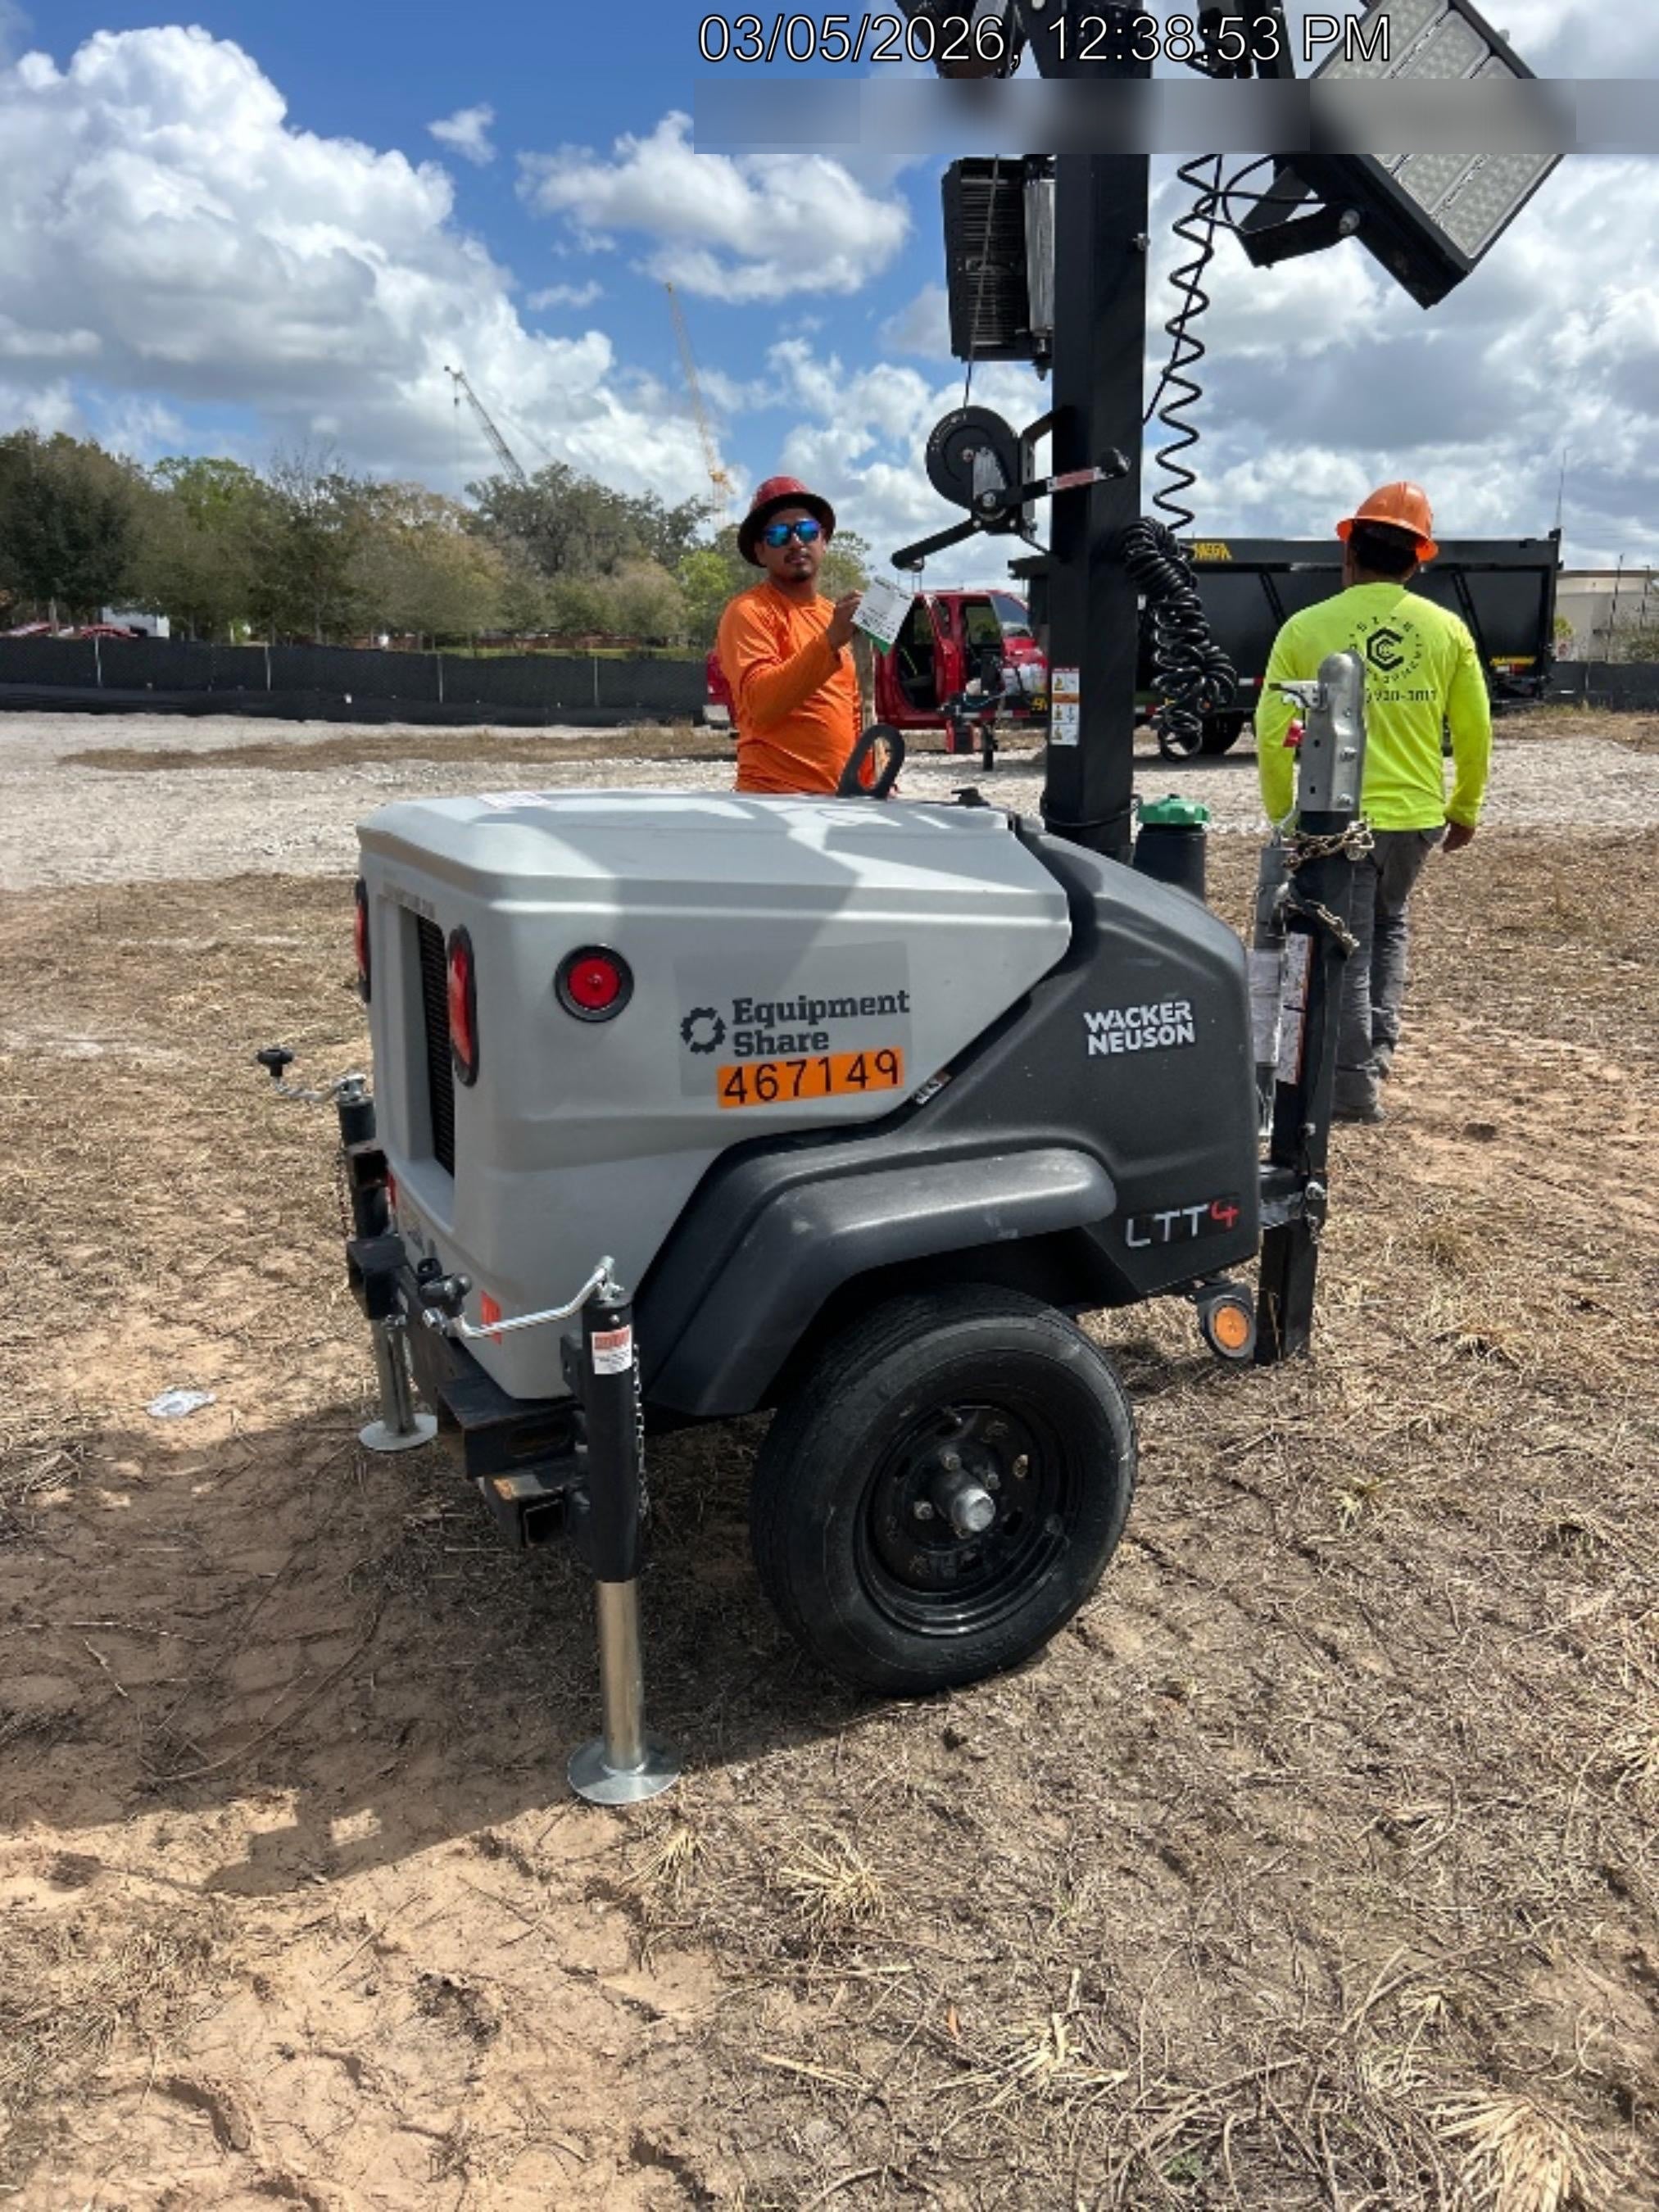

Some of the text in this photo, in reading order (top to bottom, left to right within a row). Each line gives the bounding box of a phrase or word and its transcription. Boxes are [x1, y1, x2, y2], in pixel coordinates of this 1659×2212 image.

[1194, 542, 1233, 561] MEGA
[732, 990, 911, 1027] Equipment
[1083, 1001, 1194, 1033] WACKER
[734, 1030, 830, 1057] Share
[1087, 1022, 1196, 1056] NEUSON
[724, 1049, 900, 1104] 467149
